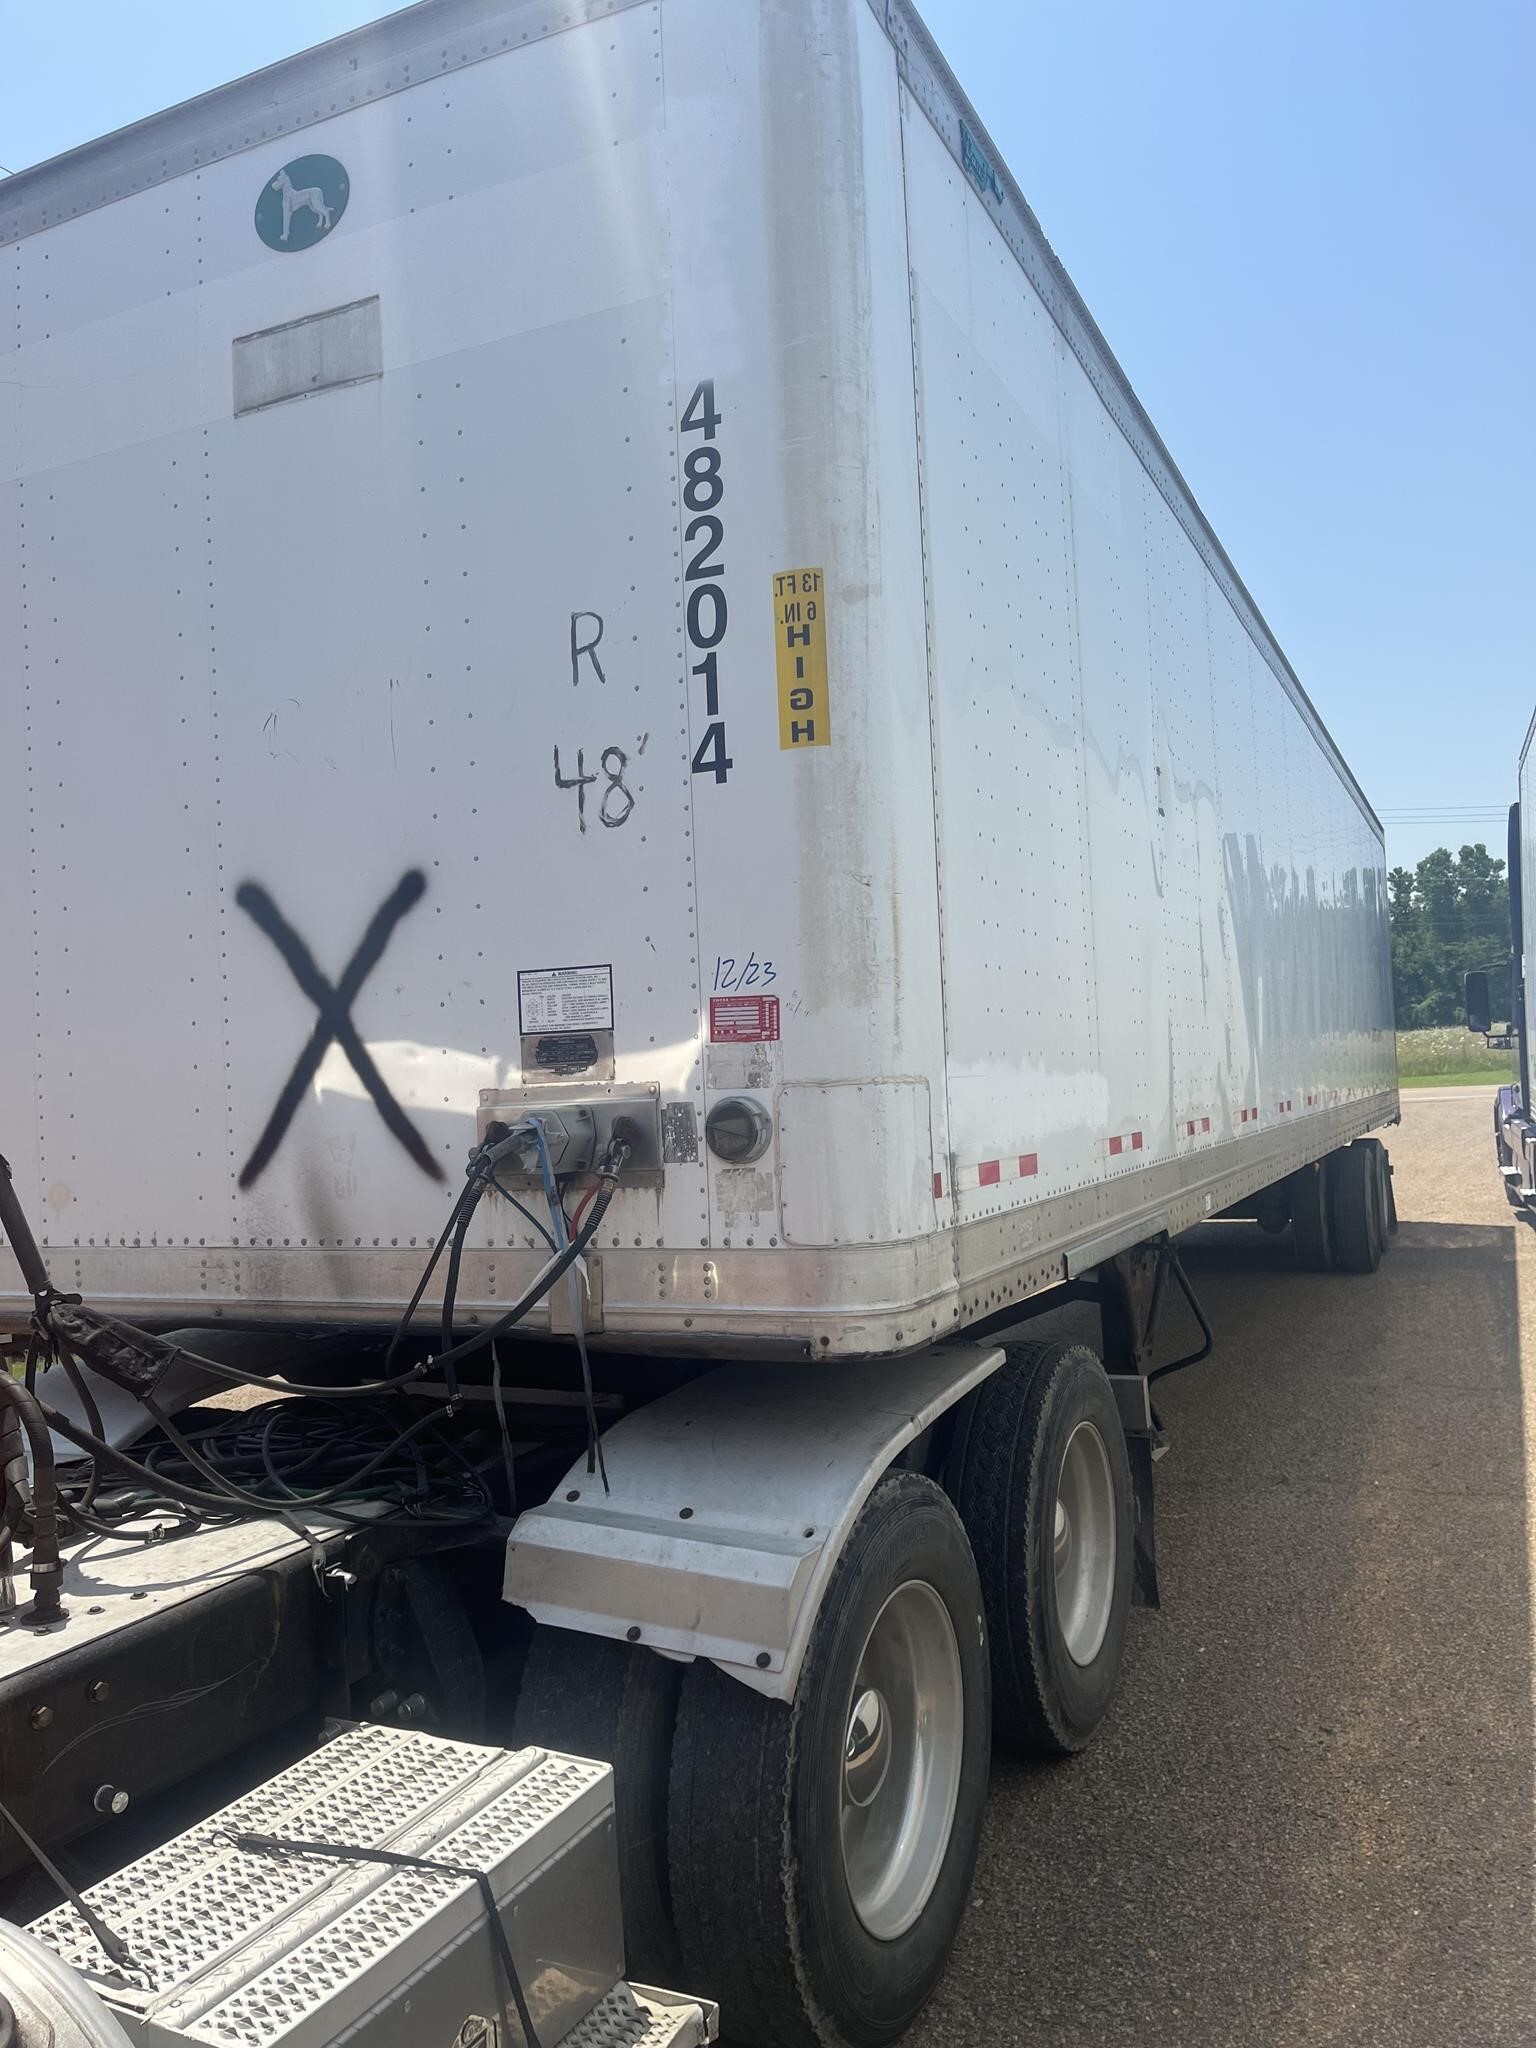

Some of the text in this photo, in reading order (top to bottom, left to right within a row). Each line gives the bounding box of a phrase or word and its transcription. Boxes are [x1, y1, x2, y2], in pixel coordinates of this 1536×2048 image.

[680, 379, 734, 784] 482014
[570, 611, 607, 687] R
[713, 951, 777, 992] 12/23
